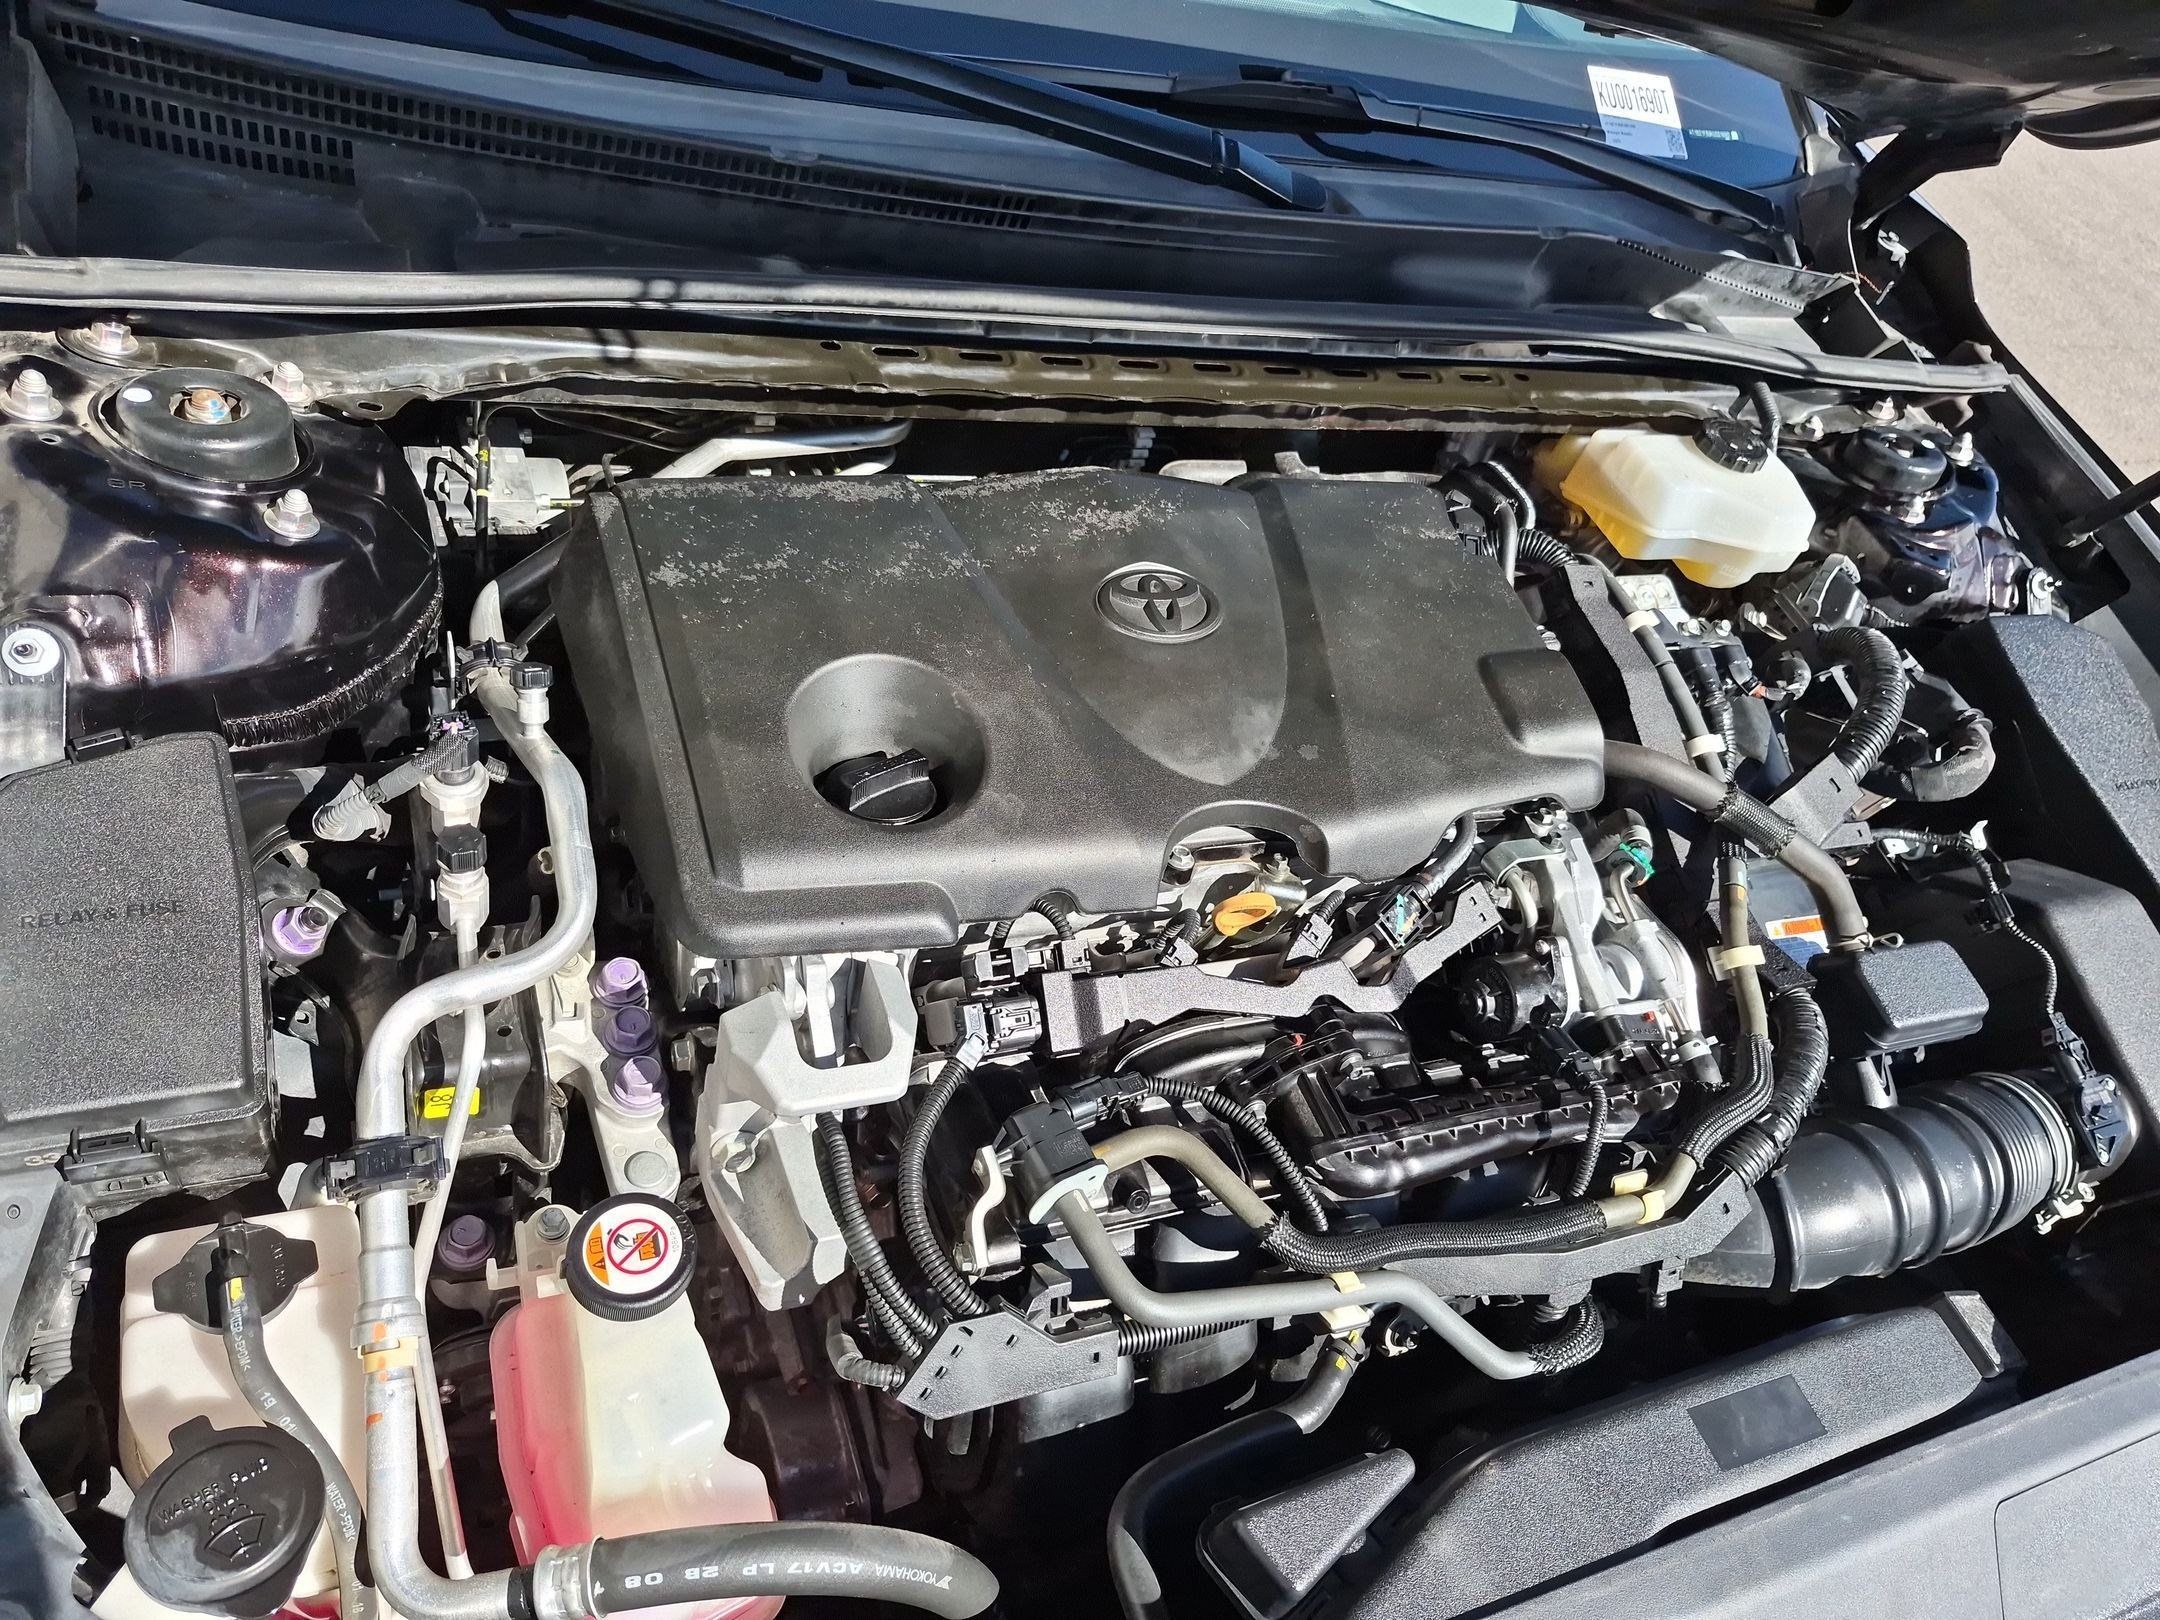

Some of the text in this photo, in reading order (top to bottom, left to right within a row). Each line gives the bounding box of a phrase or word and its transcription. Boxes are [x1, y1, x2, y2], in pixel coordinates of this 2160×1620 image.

[1596, 81, 1670, 115] KU001690T
[21, 908, 96, 928] RELAY
[156, 1482, 224, 1525] WASHER
[325, 1481, 345, 1513] WATER
[624, 1562, 937, 1589] YOKOHAMA ACV17 LP 2B 08
